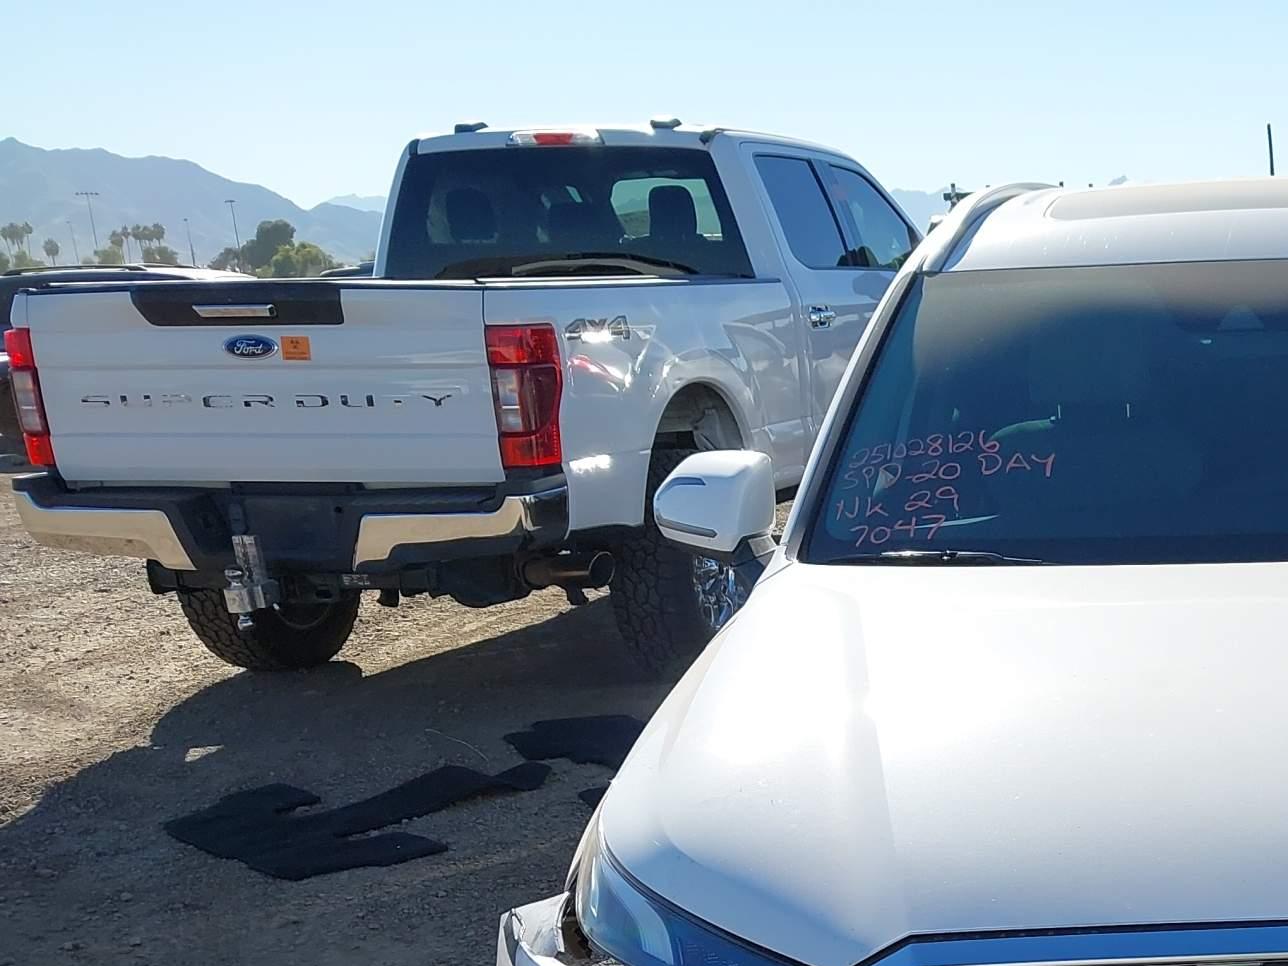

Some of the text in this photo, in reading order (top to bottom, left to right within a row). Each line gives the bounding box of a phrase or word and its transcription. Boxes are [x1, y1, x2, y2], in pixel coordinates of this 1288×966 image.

[234, 340, 263, 353] Ford
[849, 430, 1000, 468] 251028126
[978, 452, 1056, 477] DAY
[850, 514, 945, 547] 7047
